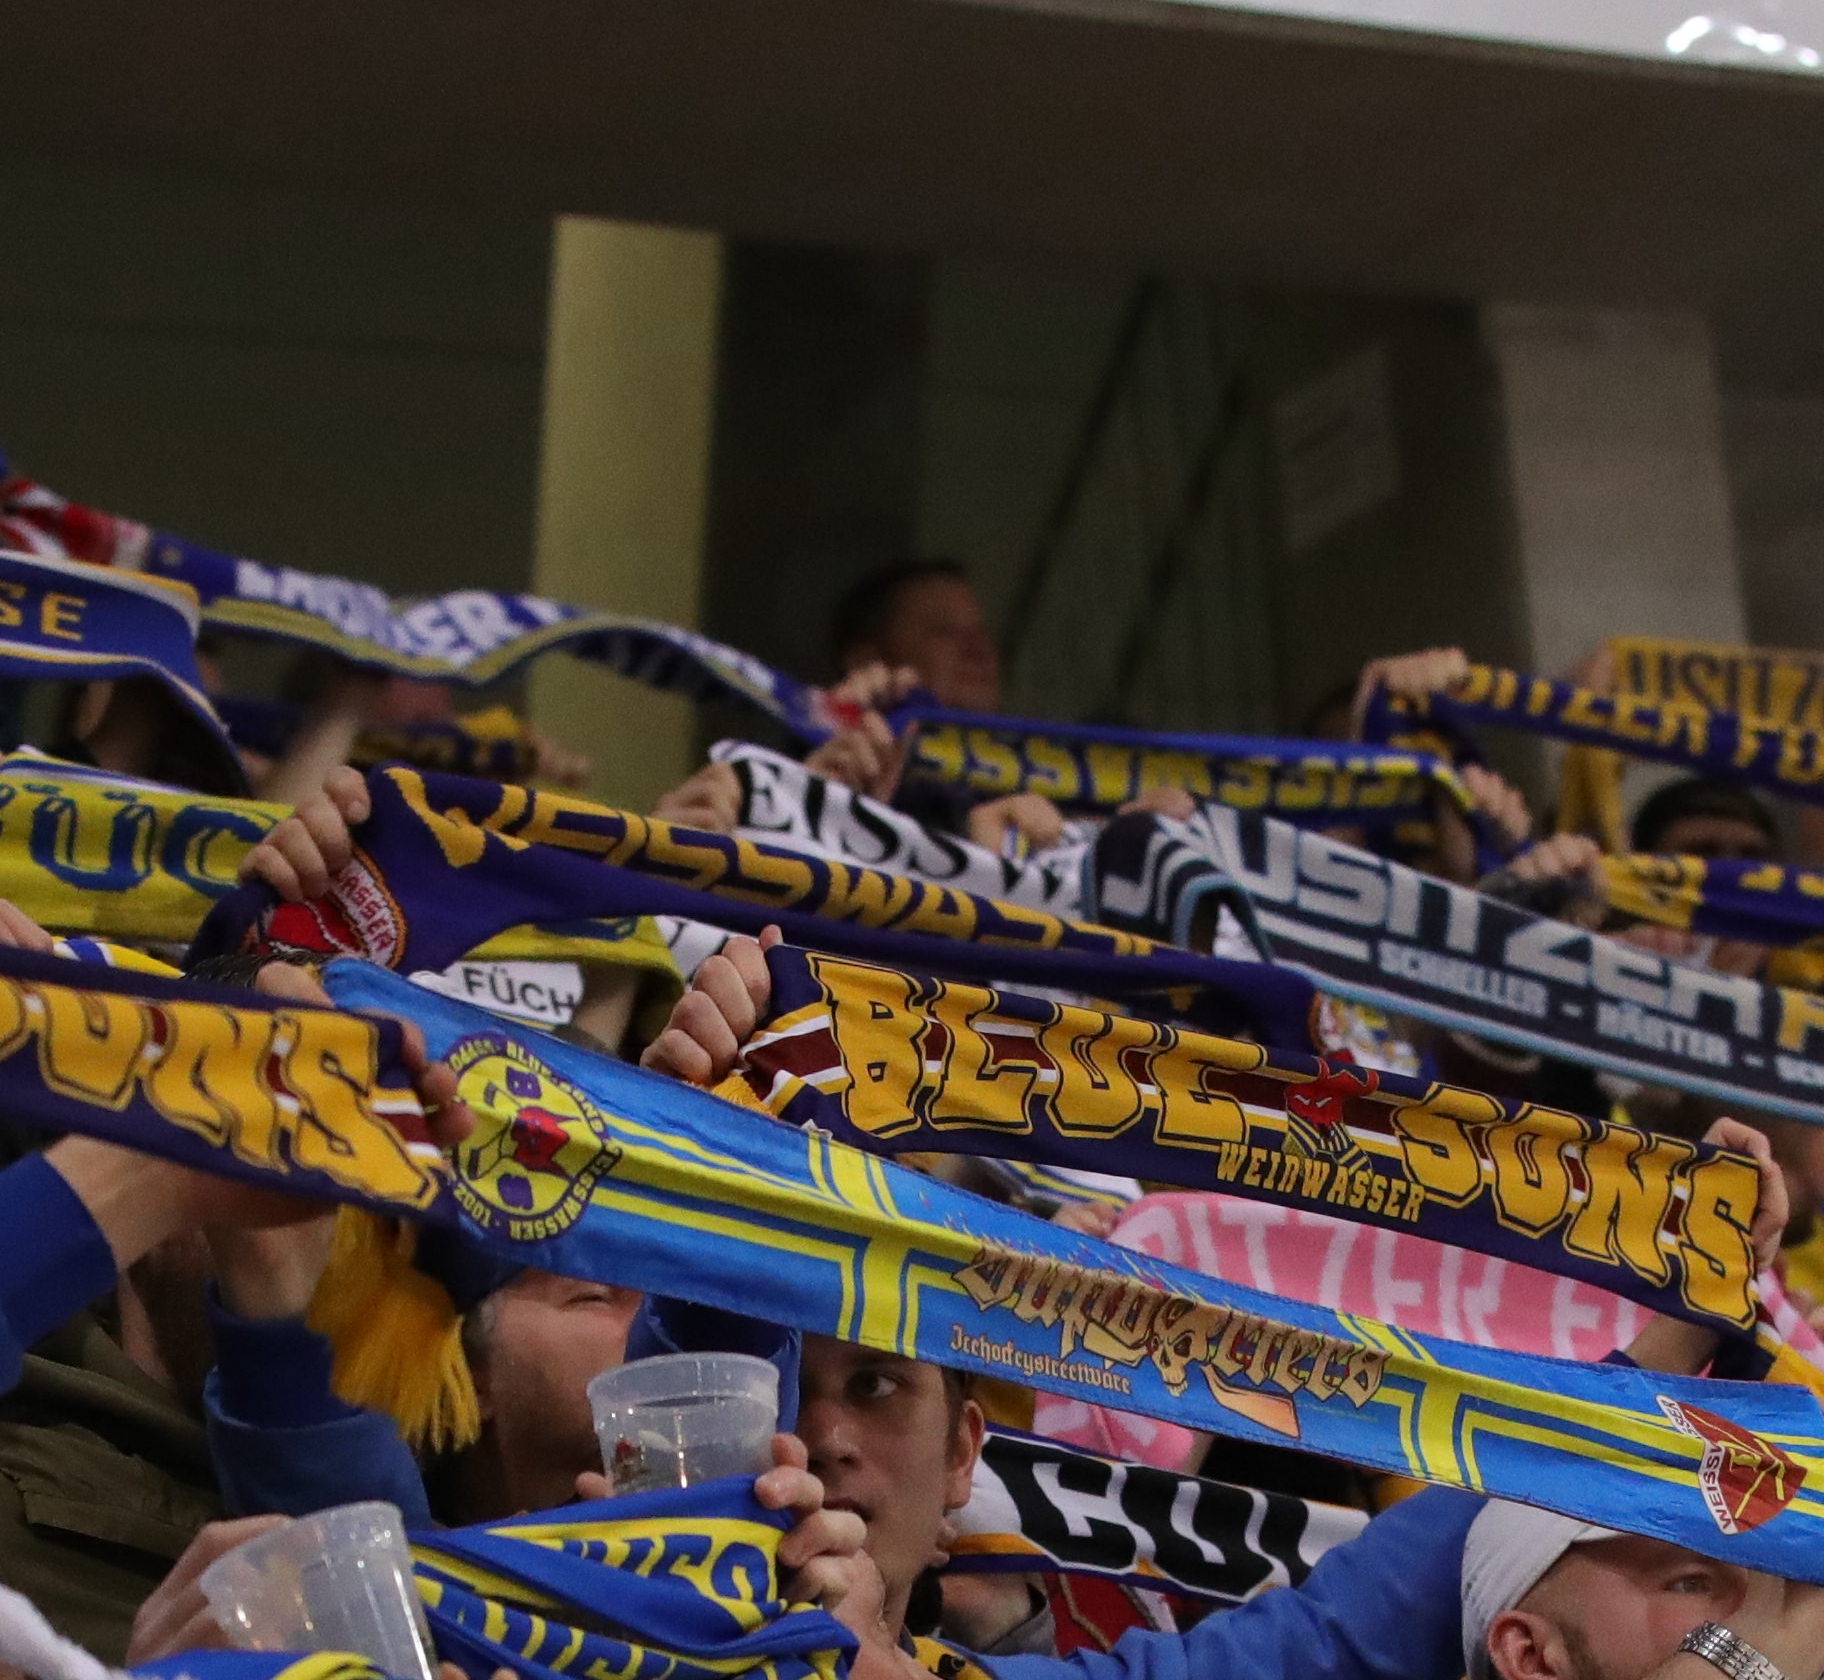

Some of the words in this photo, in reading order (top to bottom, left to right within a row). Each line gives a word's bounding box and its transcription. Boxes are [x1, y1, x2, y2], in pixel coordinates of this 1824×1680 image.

[334, 870, 398, 952] ASSER
[1200, 800, 1766, 1042] USITZER
[806, 952, 1270, 1152] BLUE
[1389, 1080, 1762, 1330] SONS
